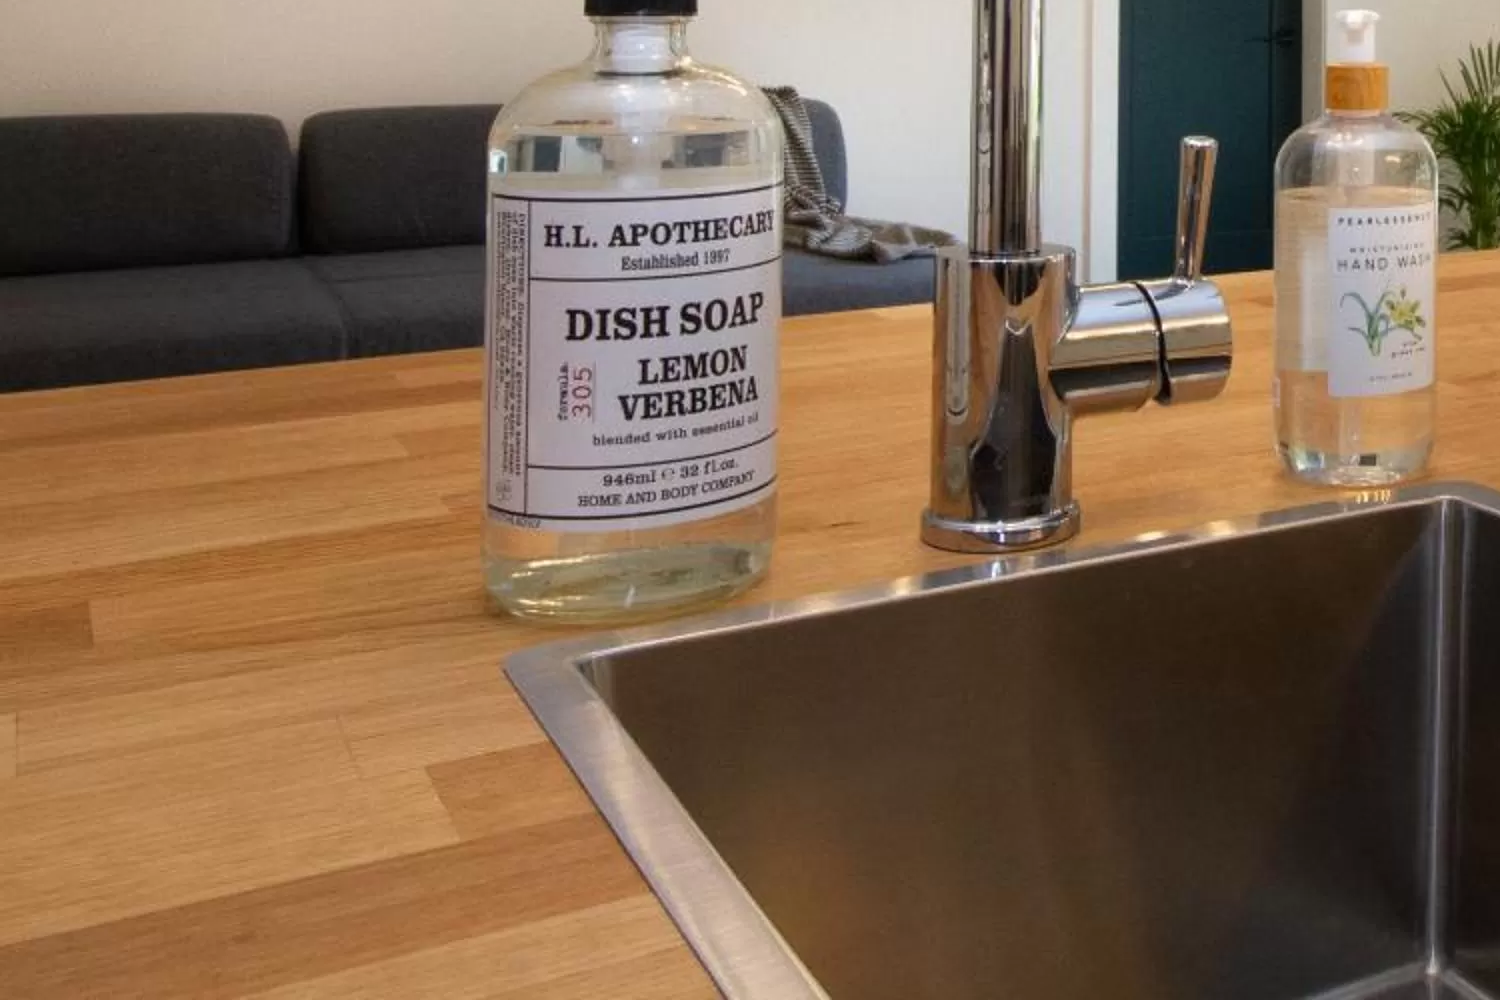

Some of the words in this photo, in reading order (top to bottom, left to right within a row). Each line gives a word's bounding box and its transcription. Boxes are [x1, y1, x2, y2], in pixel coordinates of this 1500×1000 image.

[544, 223, 599, 249] H.L.
[607, 209, 775, 248] APOTHECARY
[620, 252, 699, 271] Established
[1336, 257, 1389, 273] HAND
[564, 305, 671, 342] DISH
[678, 291, 764, 336] SOAP
[637, 345, 748, 386] LEMON
[570, 365, 594, 420] 305
[617, 376, 759, 421] VERBENA
[592, 432, 652, 447] blended
[655, 428, 688, 441] with
[577, 493, 623, 507] HOME
[625, 489, 657, 504] AND
[660, 482, 699, 499] BODY
[700, 469, 756, 492] COMPANY
[602, 471, 657, 487] 946ml
[679, 464, 700, 479] 32
